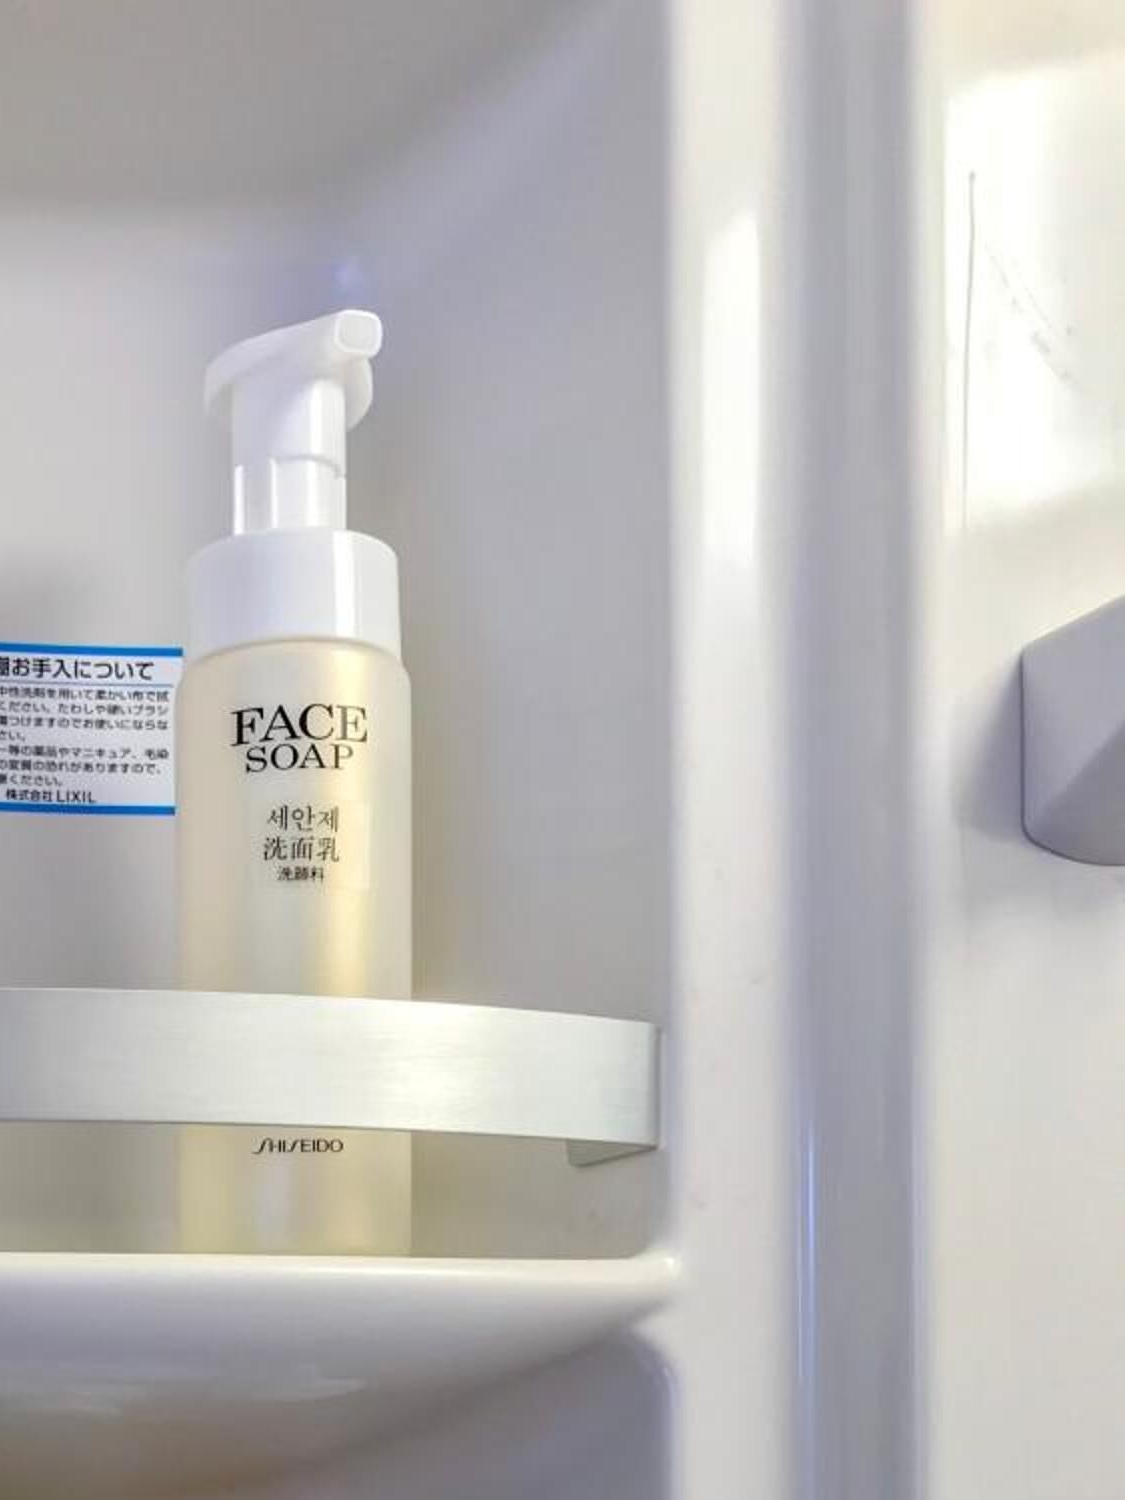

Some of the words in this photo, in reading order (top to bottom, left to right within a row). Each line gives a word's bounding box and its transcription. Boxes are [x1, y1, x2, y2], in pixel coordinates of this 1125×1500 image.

[230, 703, 369, 747] FACE
[245, 743, 354, 774] SOAP
[6, 788, 53, 802] 株式会社
[56, 789, 97, 803] LIXIL
[267, 805, 340, 833] 세안제
[263, 836, 340, 863] 洗面乳
[252, 1137, 344, 1155] SHISEIDO
